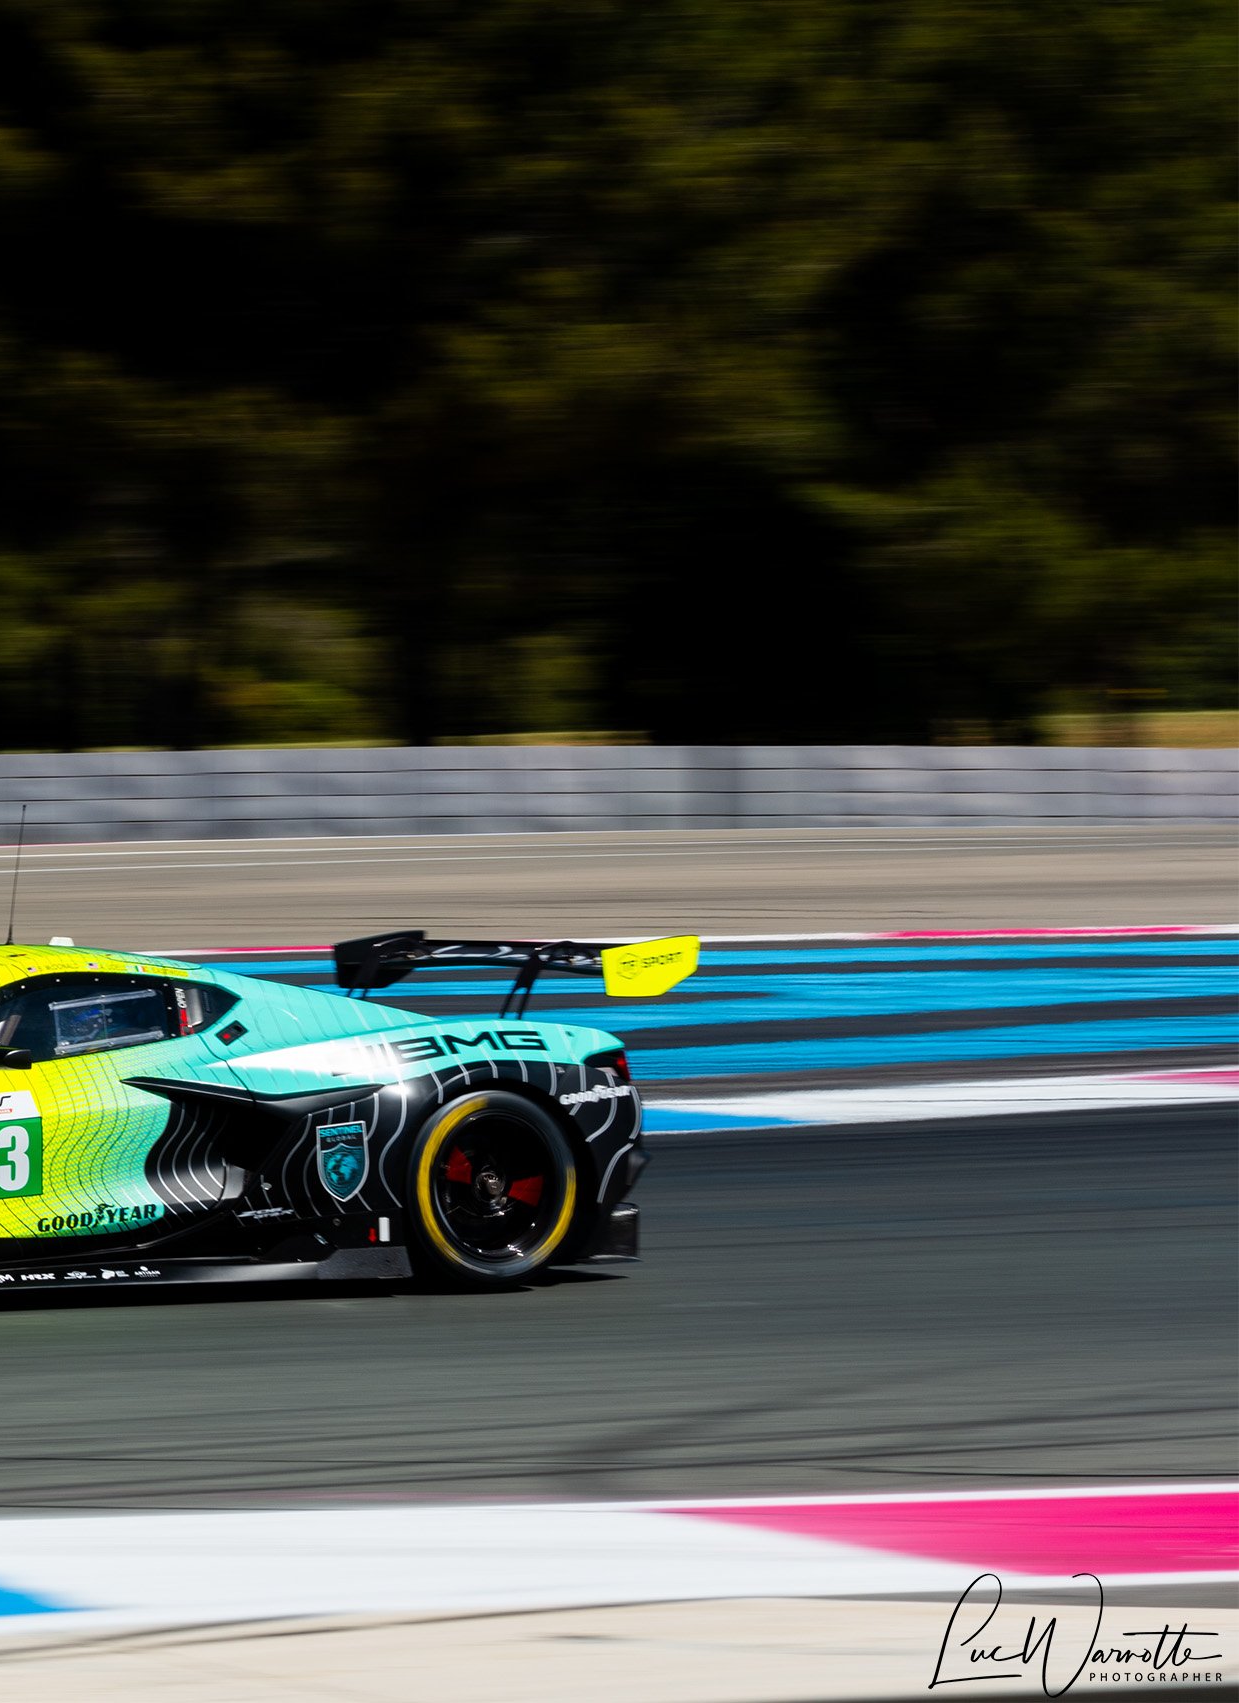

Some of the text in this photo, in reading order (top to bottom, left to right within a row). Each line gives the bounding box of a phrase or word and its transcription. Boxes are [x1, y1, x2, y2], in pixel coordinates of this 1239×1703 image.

[174, 987, 187, 1009] OPEN
[559, 1083, 632, 1105] GOODYEAR
[319, 1125, 363, 1138] SENTINEL
[37, 1203, 157, 1233] GOODYEAR
